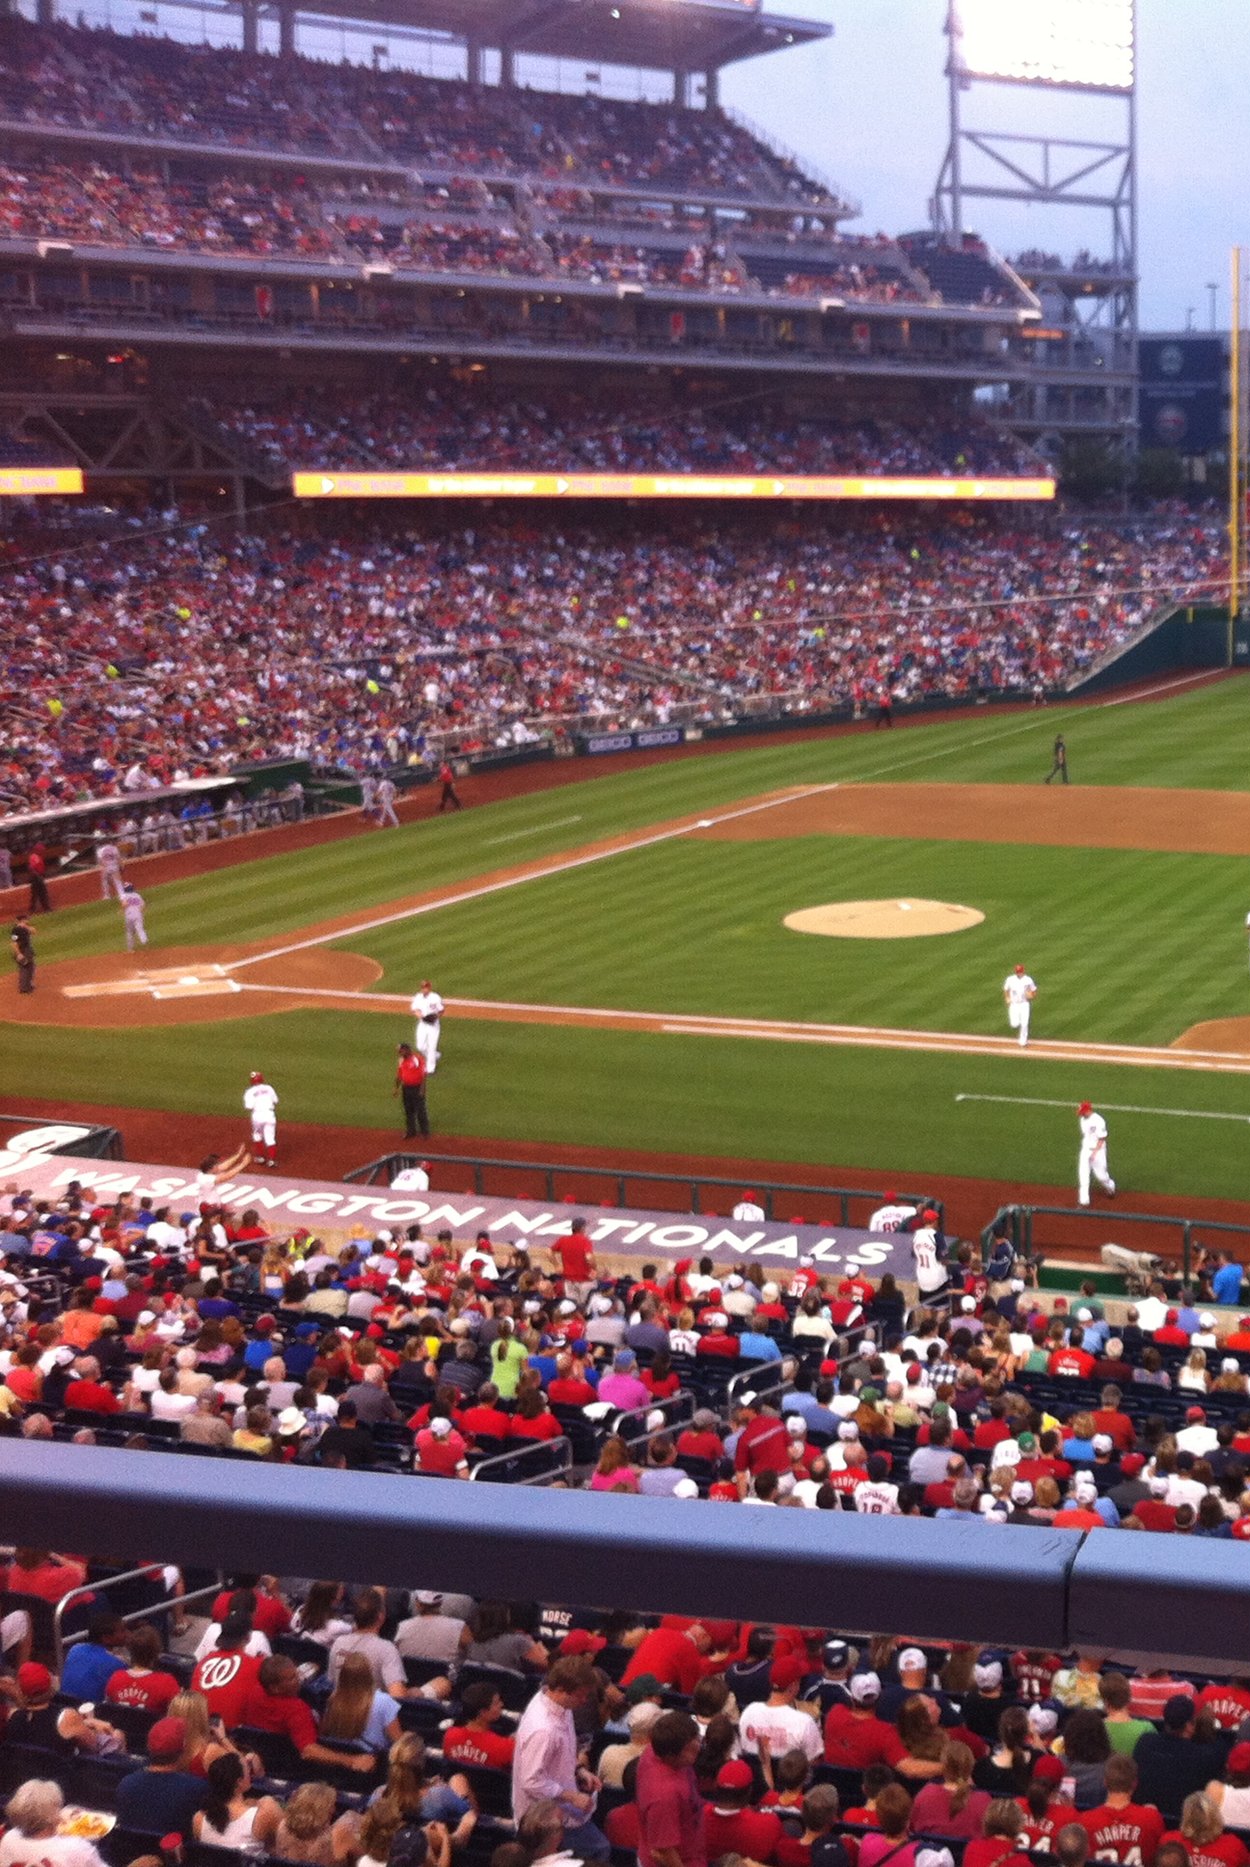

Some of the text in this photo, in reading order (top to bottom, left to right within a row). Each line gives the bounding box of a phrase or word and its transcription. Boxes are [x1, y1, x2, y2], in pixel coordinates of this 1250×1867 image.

[50, 1167, 894, 1265] WASHINGTON NATIONALS
[200, 1654, 242, 1690] W
[1093, 1823, 1142, 1847] HARPER
